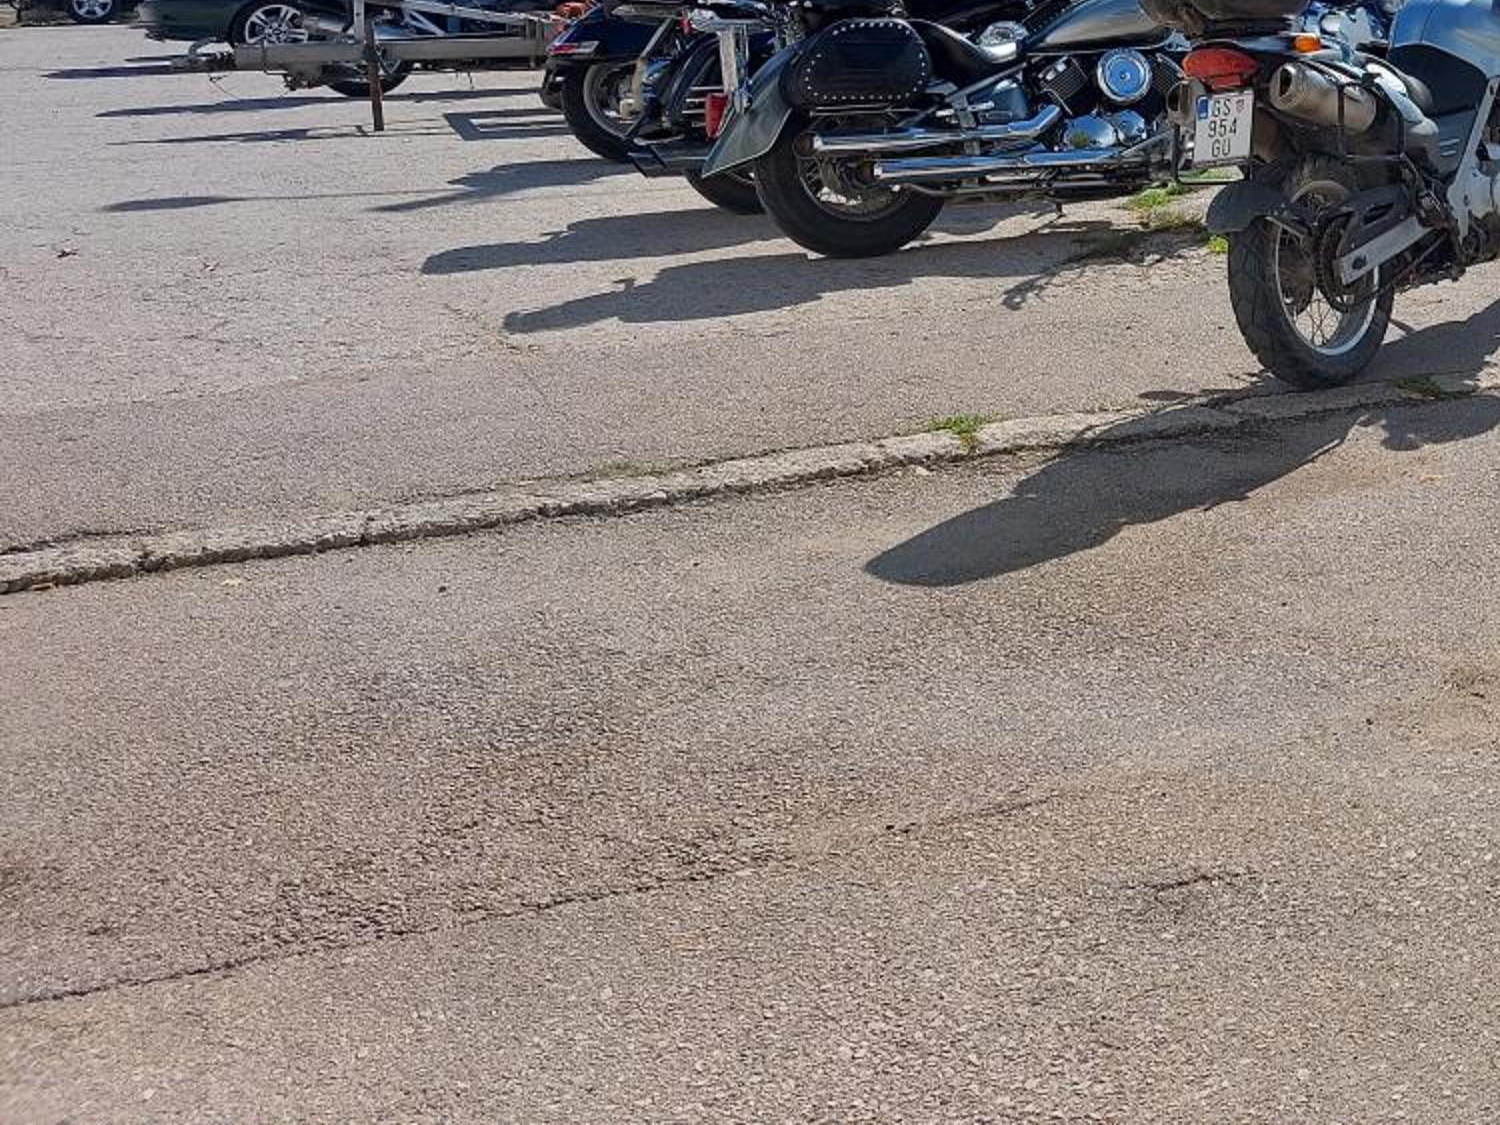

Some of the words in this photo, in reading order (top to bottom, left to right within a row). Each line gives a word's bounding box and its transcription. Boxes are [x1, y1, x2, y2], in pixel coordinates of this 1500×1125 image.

[1211, 98, 1231, 117] GS
[1208, 118, 1237, 138] 954
[1211, 138, 1231, 157] GU
